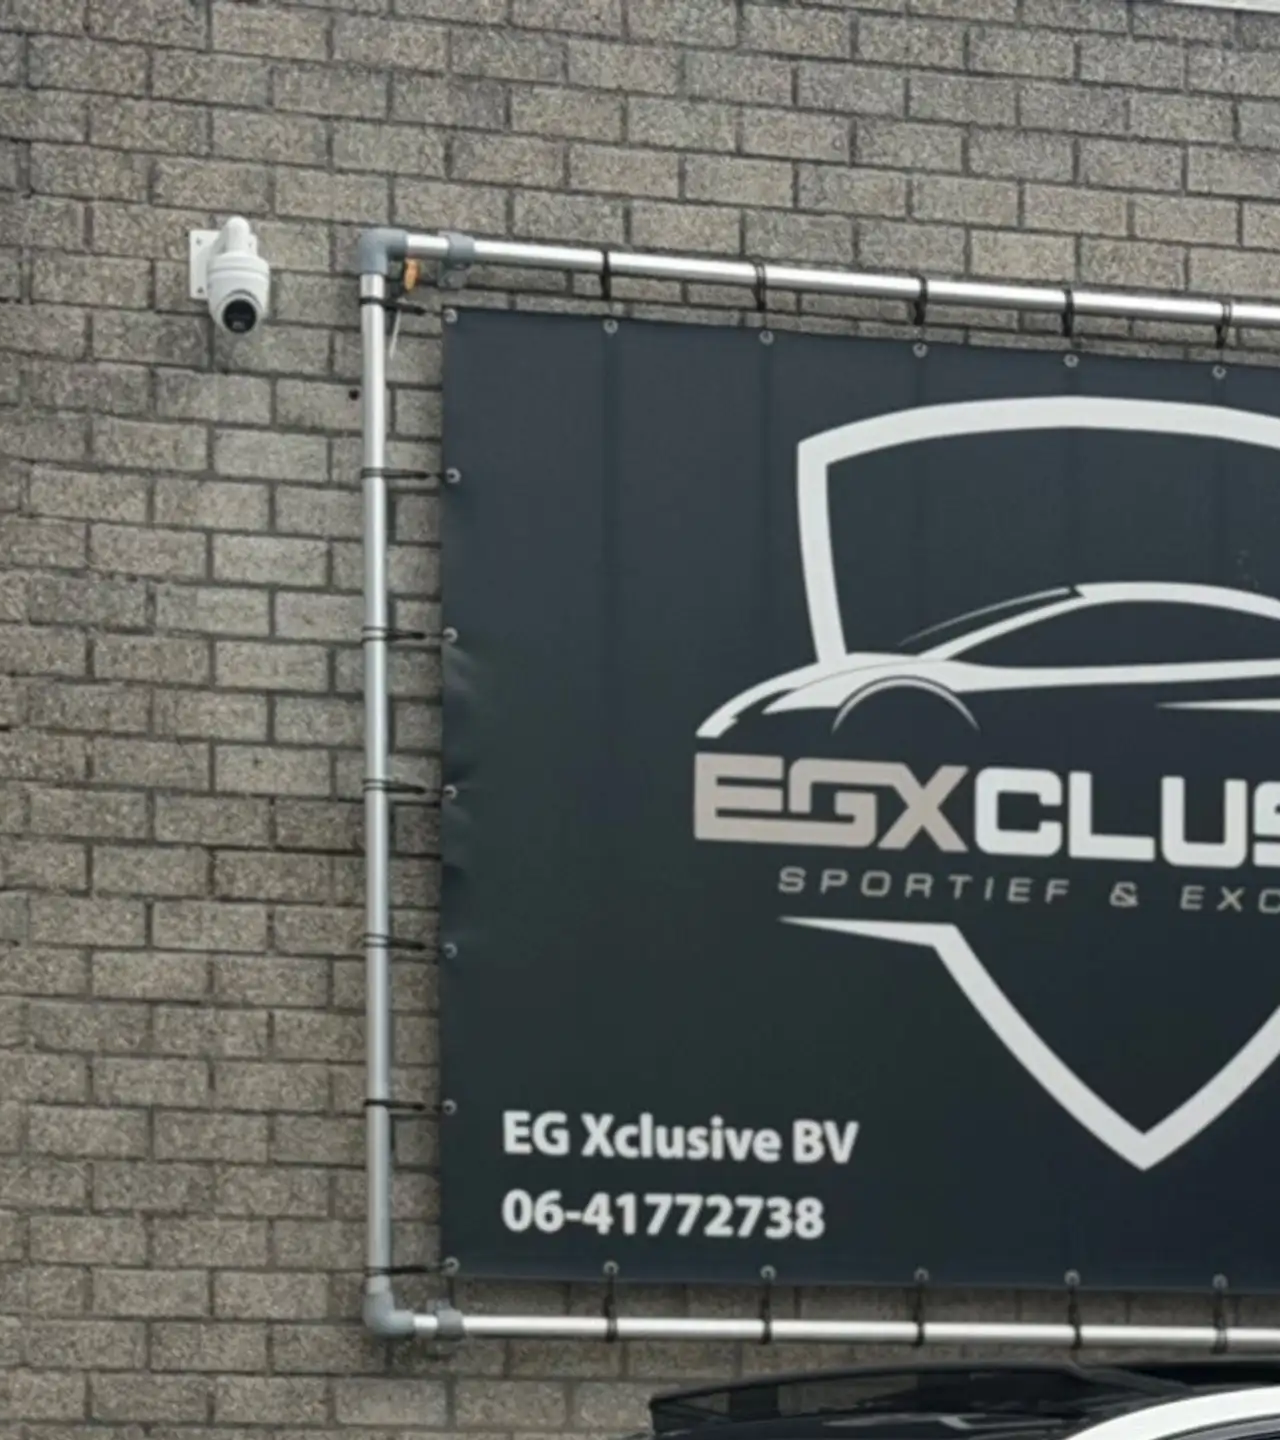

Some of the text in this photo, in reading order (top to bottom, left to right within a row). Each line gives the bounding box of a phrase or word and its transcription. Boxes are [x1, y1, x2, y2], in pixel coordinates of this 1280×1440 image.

[778, 867, 1071, 904] SPORTIEF
[1109, 881, 1139, 907] &
[503, 1111, 859, 1164] EG Xclusive BV
[502, 1189, 825, 1239] 06-41772738
